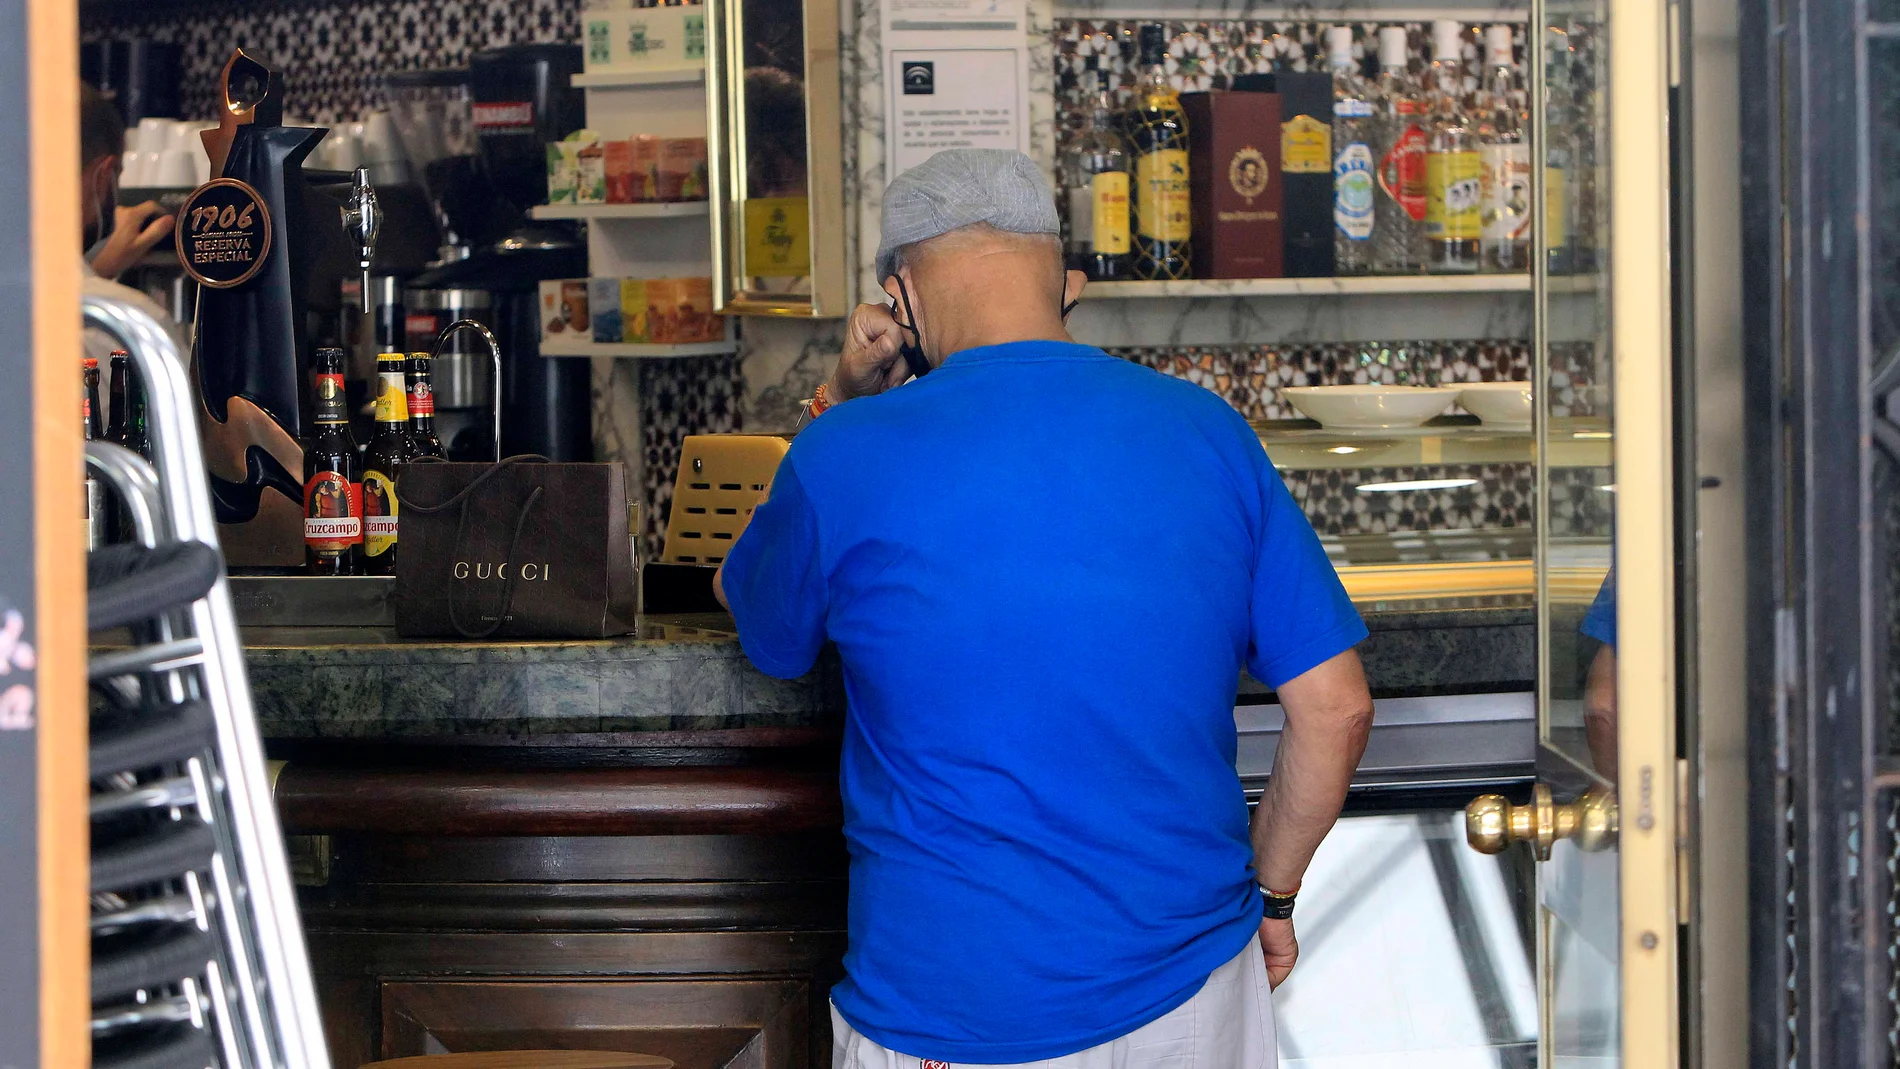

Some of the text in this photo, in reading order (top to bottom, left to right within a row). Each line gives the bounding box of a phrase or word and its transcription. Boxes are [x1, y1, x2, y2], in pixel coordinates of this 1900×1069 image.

[191, 201, 255, 233] 1906
[195, 238, 251, 252] RESERVA
[194, 251, 253, 264] ESPECIAL
[454, 561, 550, 581] GUCCI
